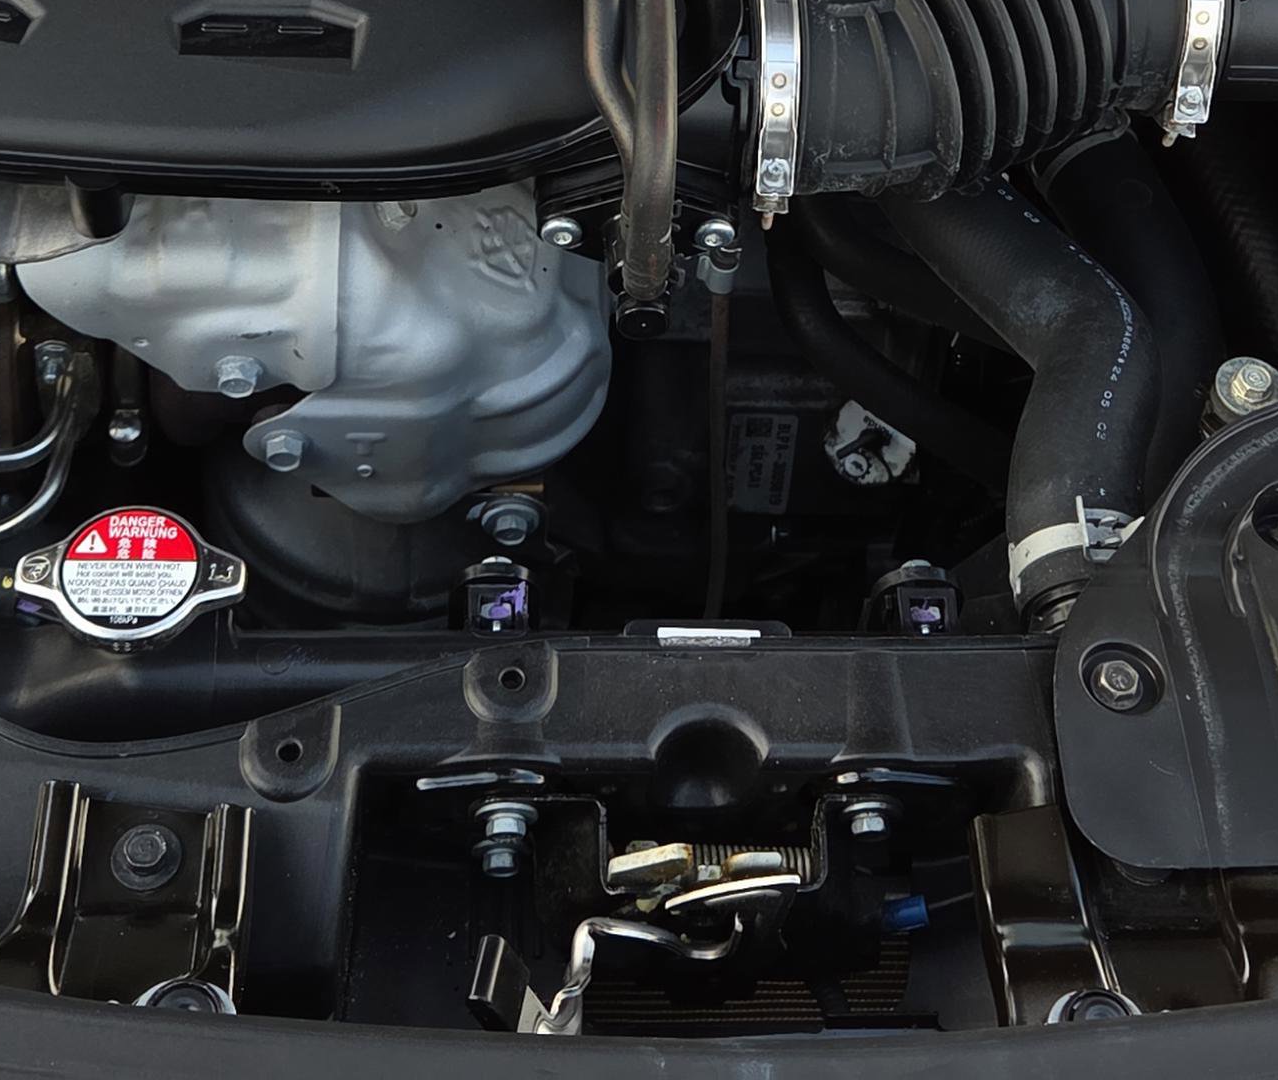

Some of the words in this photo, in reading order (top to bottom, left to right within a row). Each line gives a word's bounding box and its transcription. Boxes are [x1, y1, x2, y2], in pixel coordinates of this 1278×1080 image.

[1100, 390, 1113, 408] 05
[109, 516, 167, 527] DANGER
[108, 526, 178, 539] WARNUNG
[109, 562, 133, 570] OPEN
[135, 562, 161, 570] WHEN
[76, 570, 90, 578] Hot
[92, 570, 120, 578] coolant
[109, 579, 127, 587] PAS
[128, 579, 157, 588] QUAND
[158, 579, 187, 588] CHAUD
[69, 588, 90, 596] NICHT
[132, 588, 156, 596] MOTOR
